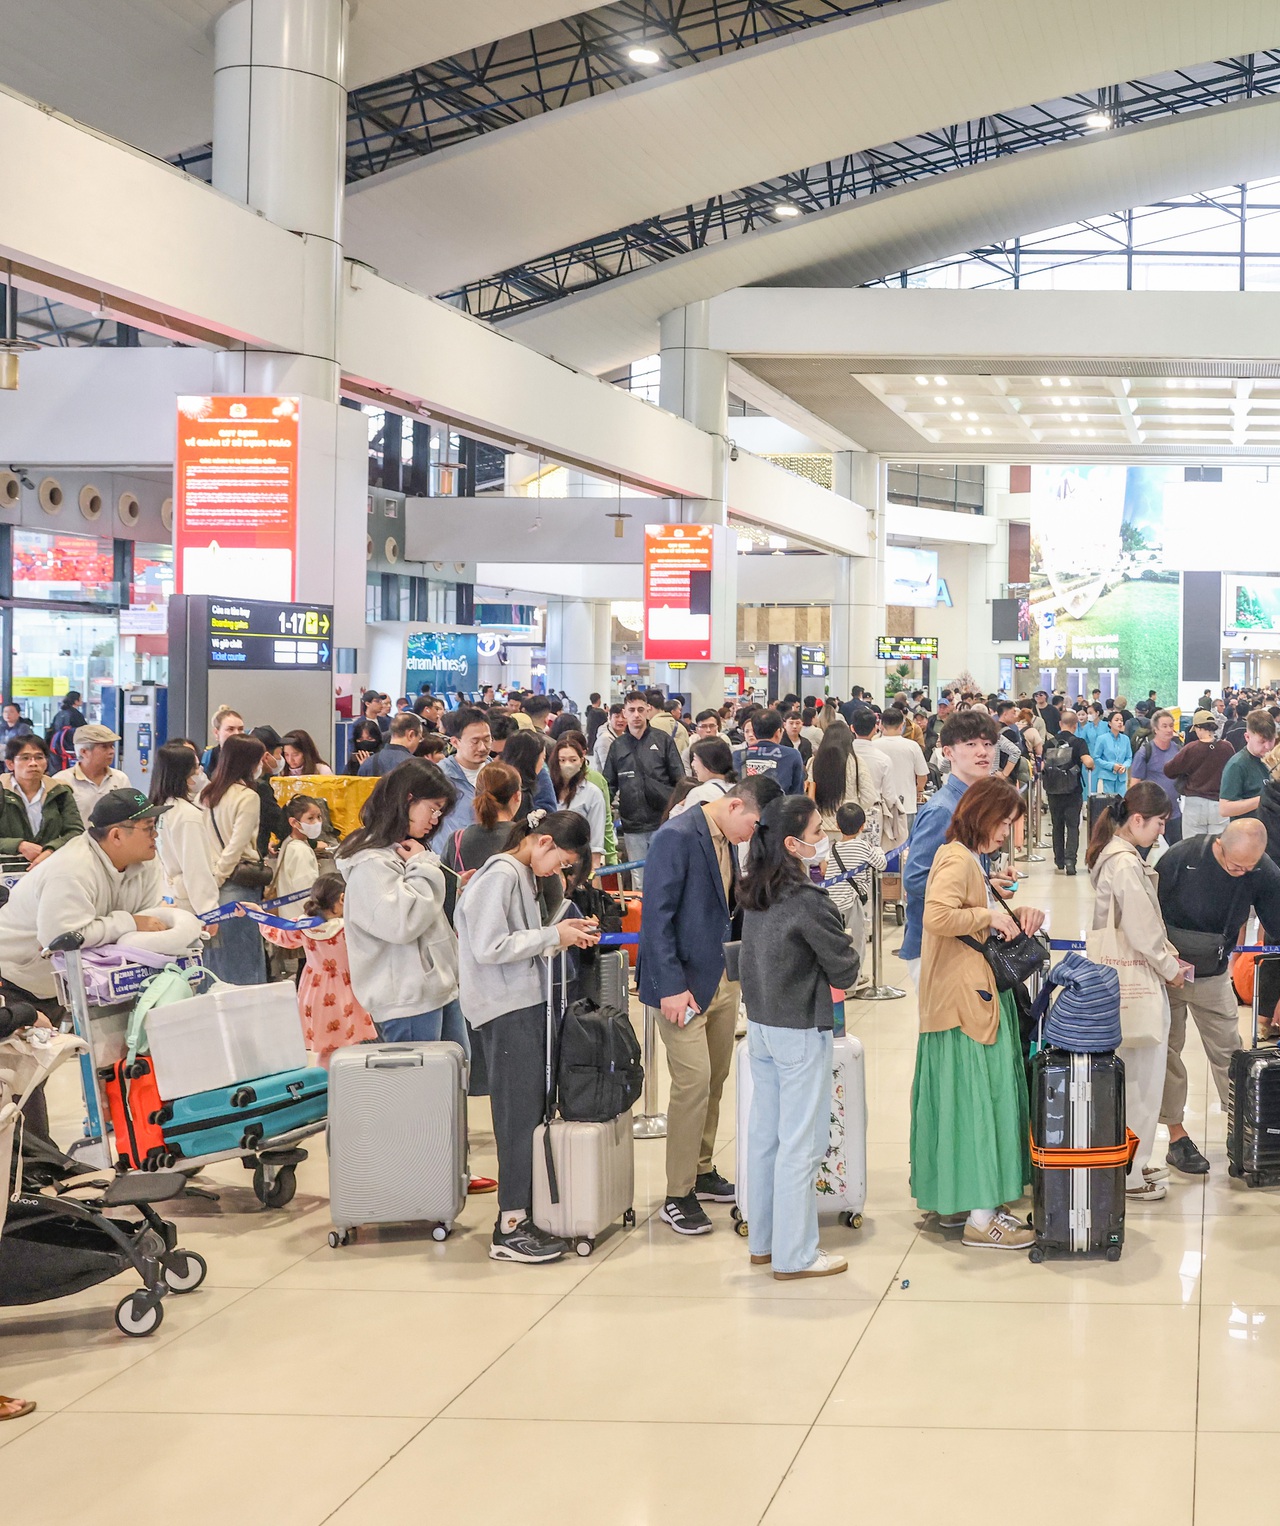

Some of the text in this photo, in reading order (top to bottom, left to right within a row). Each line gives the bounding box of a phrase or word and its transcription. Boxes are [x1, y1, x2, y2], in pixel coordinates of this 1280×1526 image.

[211, 617, 249, 631] Boarding gates
[279, 611, 306, 634] 1-17
[211, 652, 246, 662] Ticket counter
[432, 655, 459, 671] Airlines
[747, 746, 782, 758] FILA
